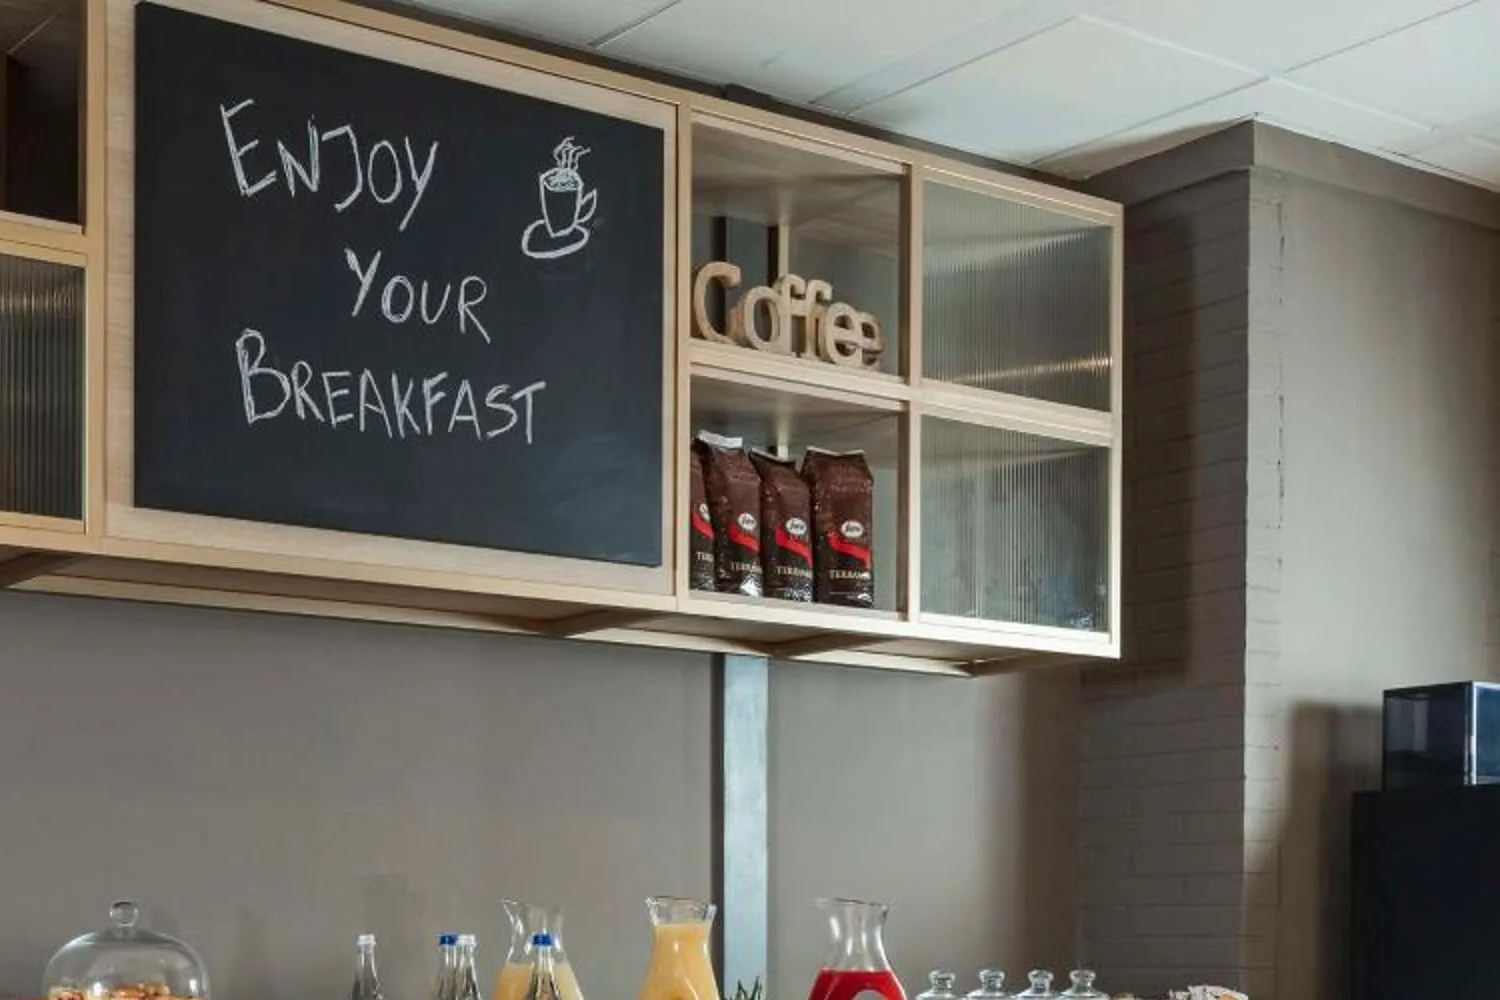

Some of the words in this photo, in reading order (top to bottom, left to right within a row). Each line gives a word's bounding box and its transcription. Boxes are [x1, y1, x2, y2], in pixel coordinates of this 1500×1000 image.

[219, 98, 438, 231] ENJOY
[344, 248, 490, 344] YOUR
[693, 261, 886, 371] Coffee
[234, 328, 546, 444] BREAKFAST
